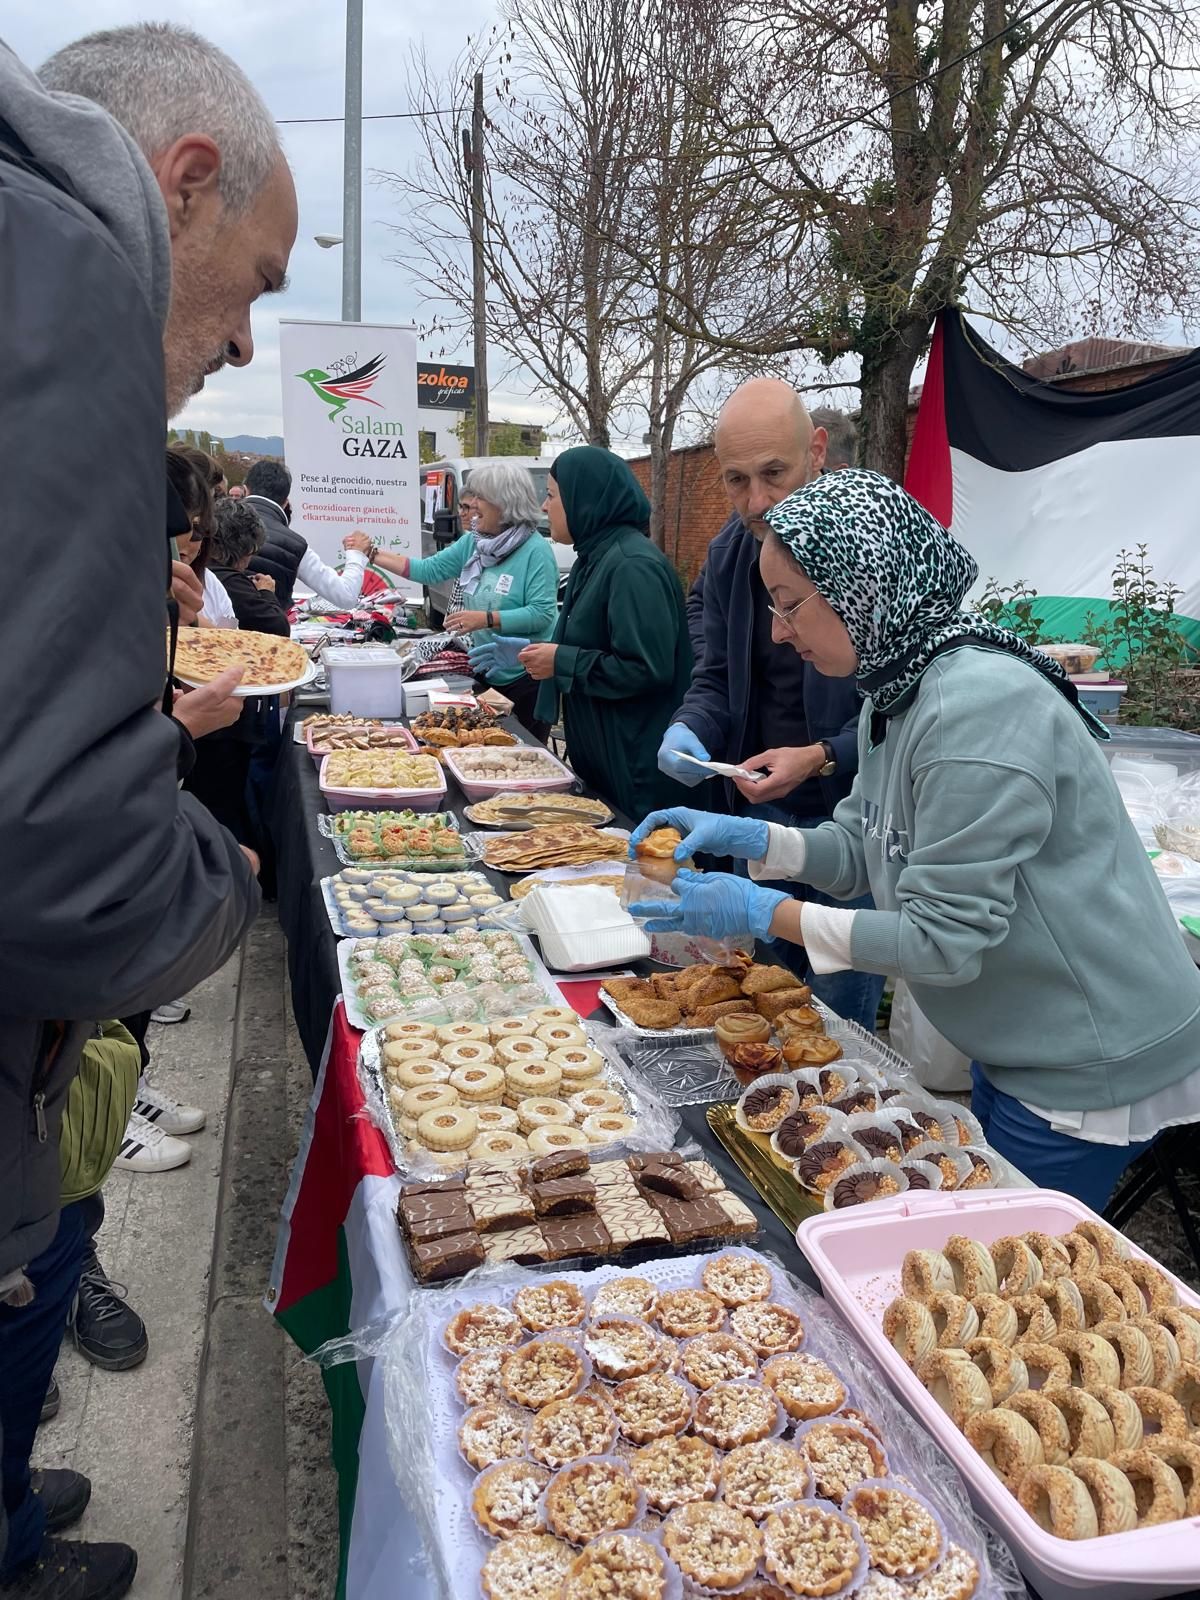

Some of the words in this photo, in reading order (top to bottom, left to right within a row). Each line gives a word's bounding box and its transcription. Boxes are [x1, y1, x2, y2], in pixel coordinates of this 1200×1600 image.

[417, 367, 469, 388] zokoa
[342, 415, 404, 436] Salam
[342, 437, 408, 459] GAZA
[300, 473, 320, 483] Pese
[321, 474, 329, 483] al
[331, 475, 374, 487] genocidio,
[375, 478, 408, 487] nuestra
[301, 485, 337, 494] voluntad
[339, 487, 384, 496] continuará
[301, 502, 361, 513] Genozidioaren
[363, 505, 398, 515] gainetik,
[302, 513, 354, 523] elkartasunak
[356, 515, 397, 525] jarraituko
[398, 516, 409, 525] du
[389, 535, 410, 550] رغم
